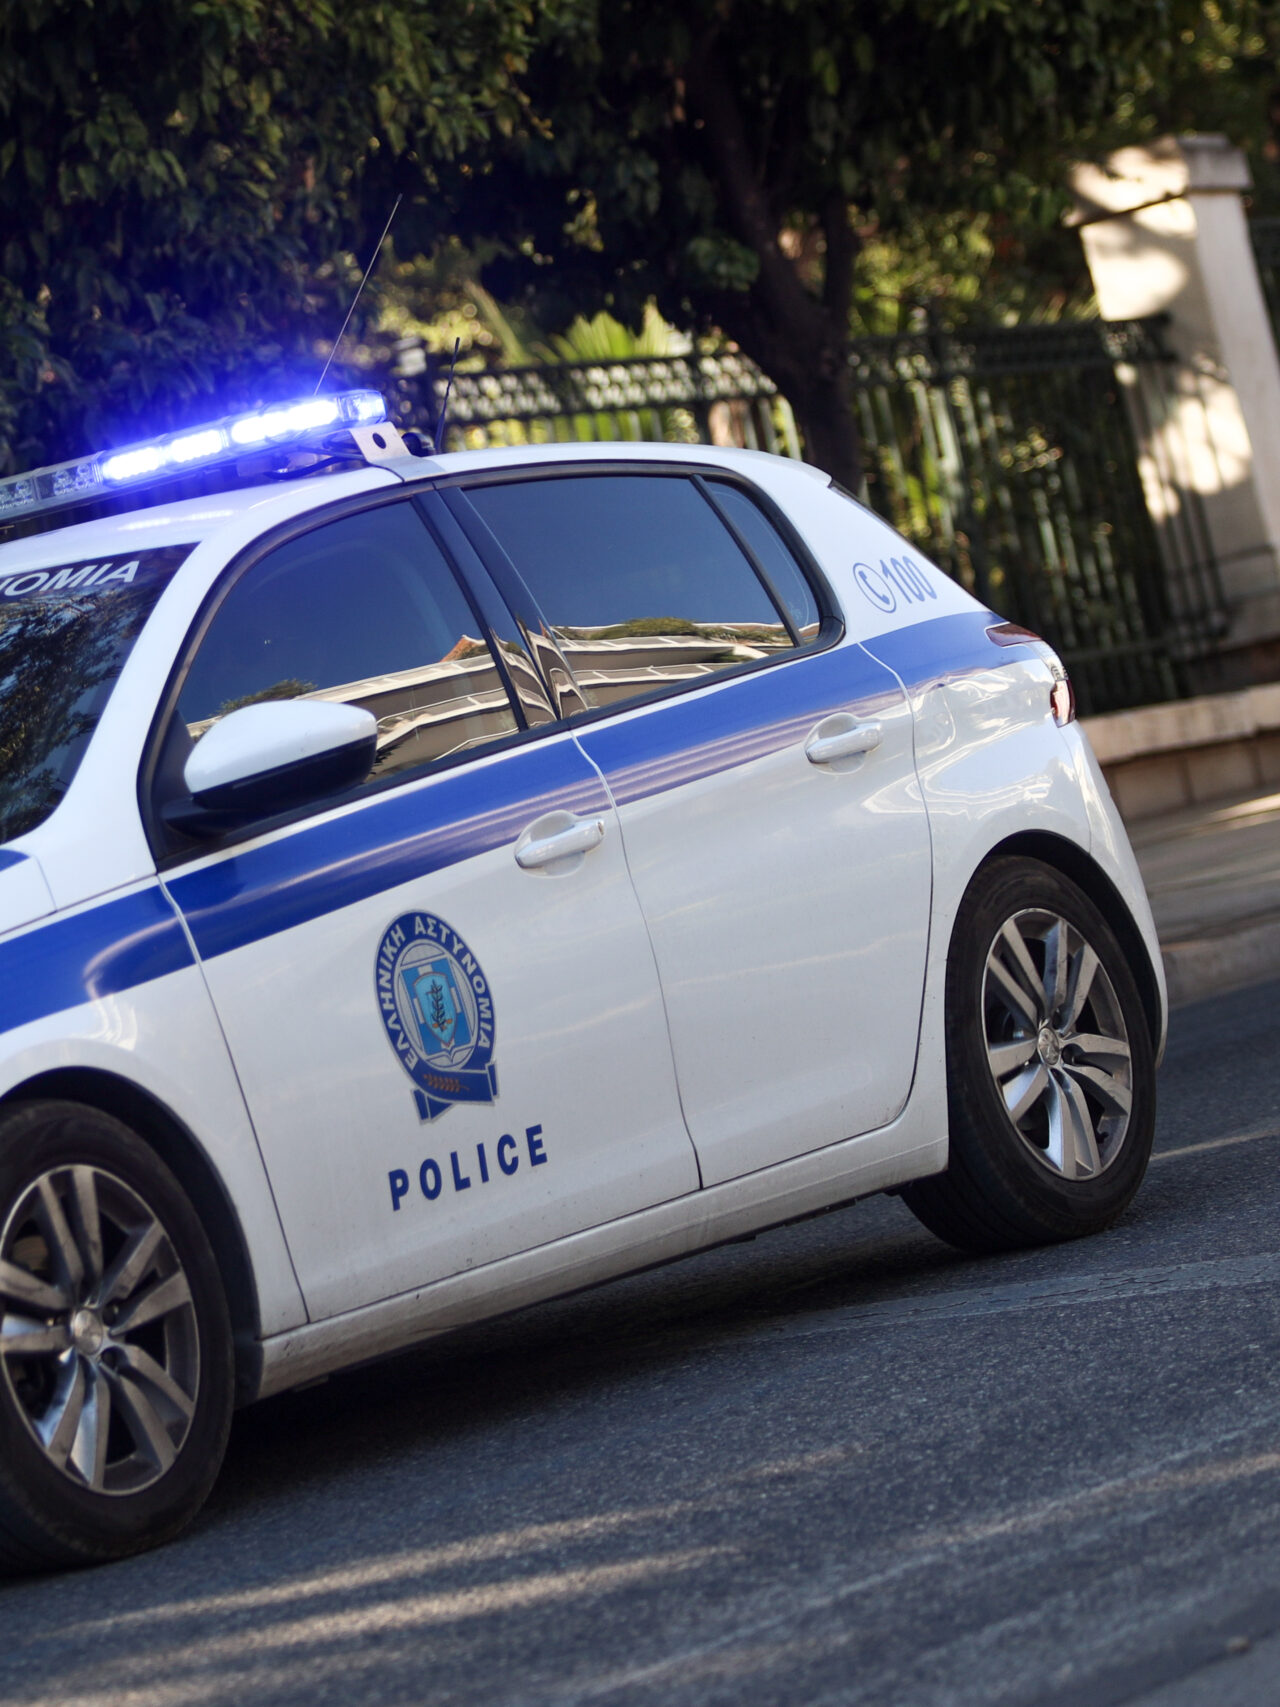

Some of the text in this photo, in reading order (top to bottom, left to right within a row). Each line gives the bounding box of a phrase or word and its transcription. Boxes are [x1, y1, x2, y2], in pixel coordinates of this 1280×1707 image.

[879, 555, 938, 605] 100
[377, 915, 493, 1071] ΕΛΛΗΝΙΚΗ ΑΣΤΥΝΟΜΙΑ
[388, 1123, 548, 1212] POLICE
